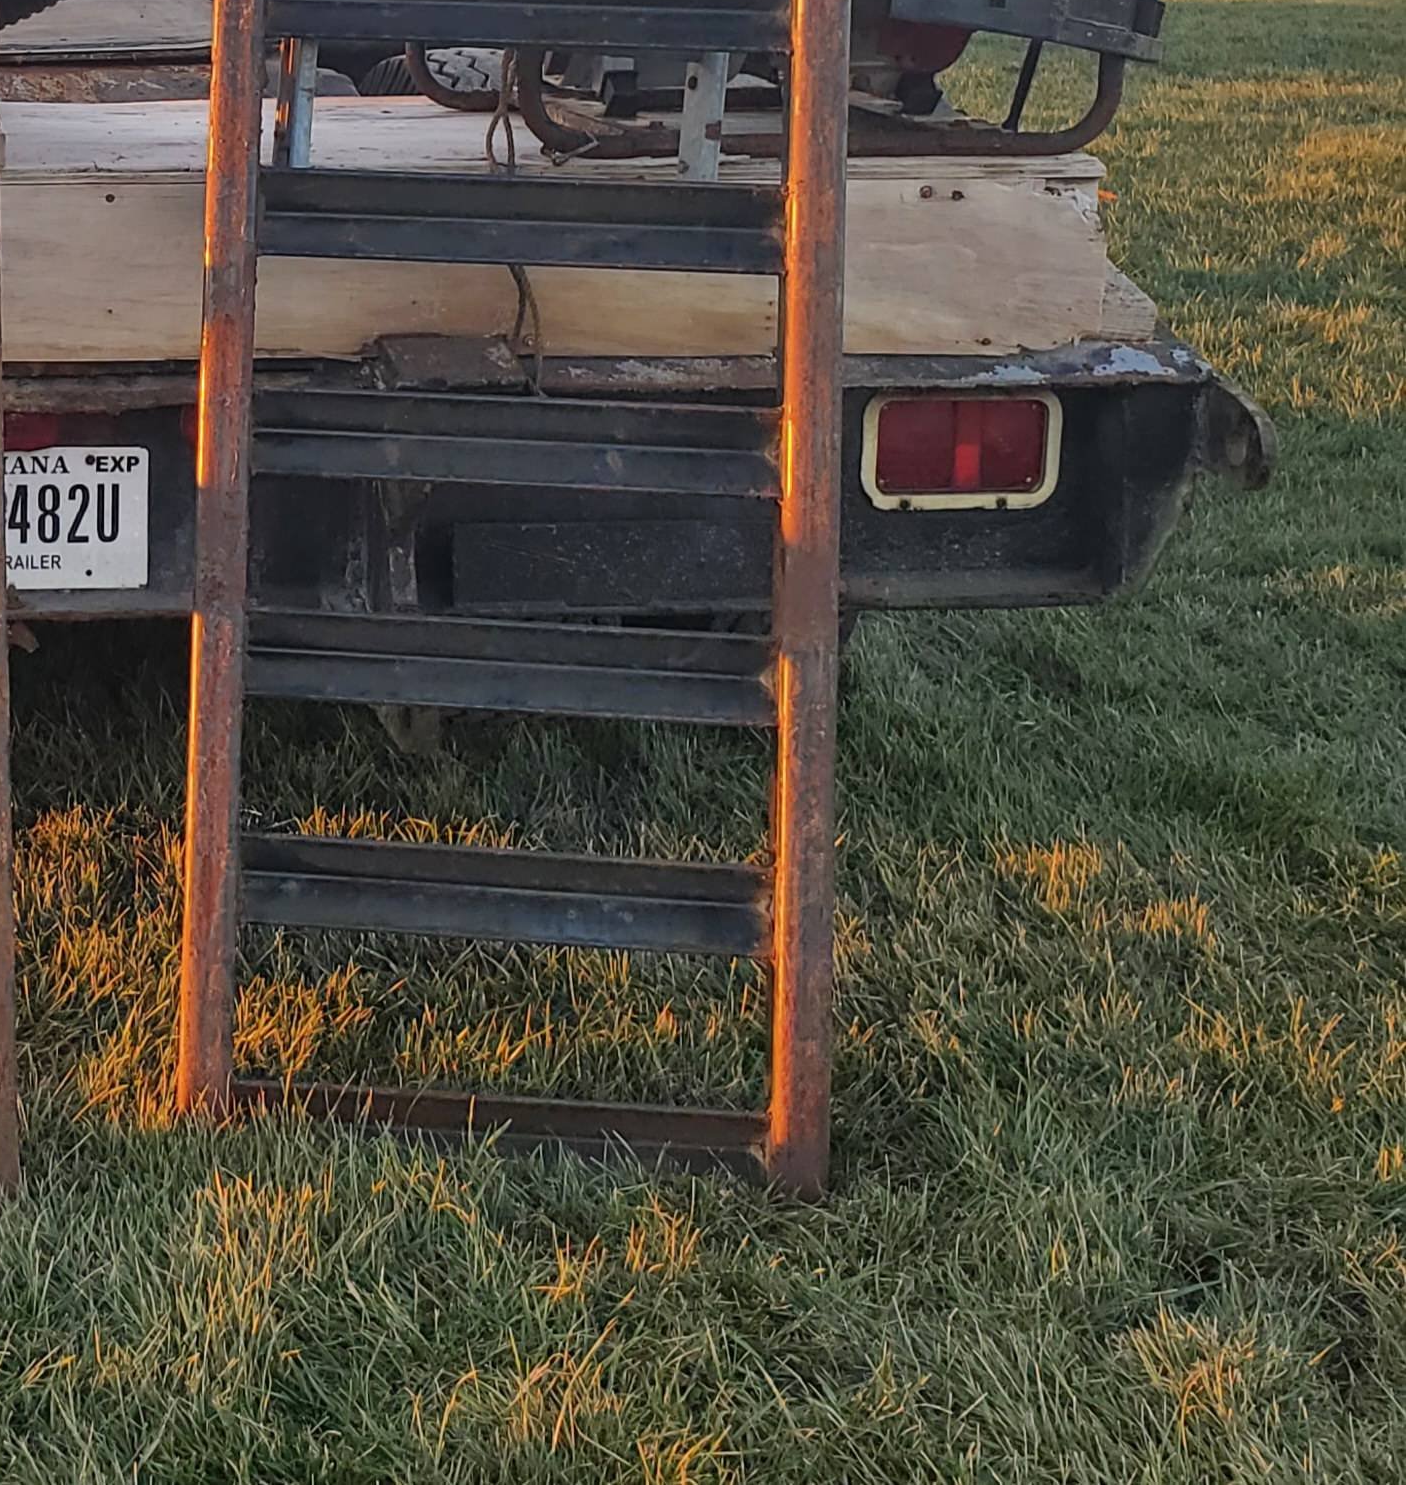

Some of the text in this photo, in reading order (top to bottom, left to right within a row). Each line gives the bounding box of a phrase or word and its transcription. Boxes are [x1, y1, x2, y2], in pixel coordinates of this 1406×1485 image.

[4, 455, 140, 475] IANA EXP
[5, 483, 120, 544] 482U
[5, 554, 62, 570] RAILER
